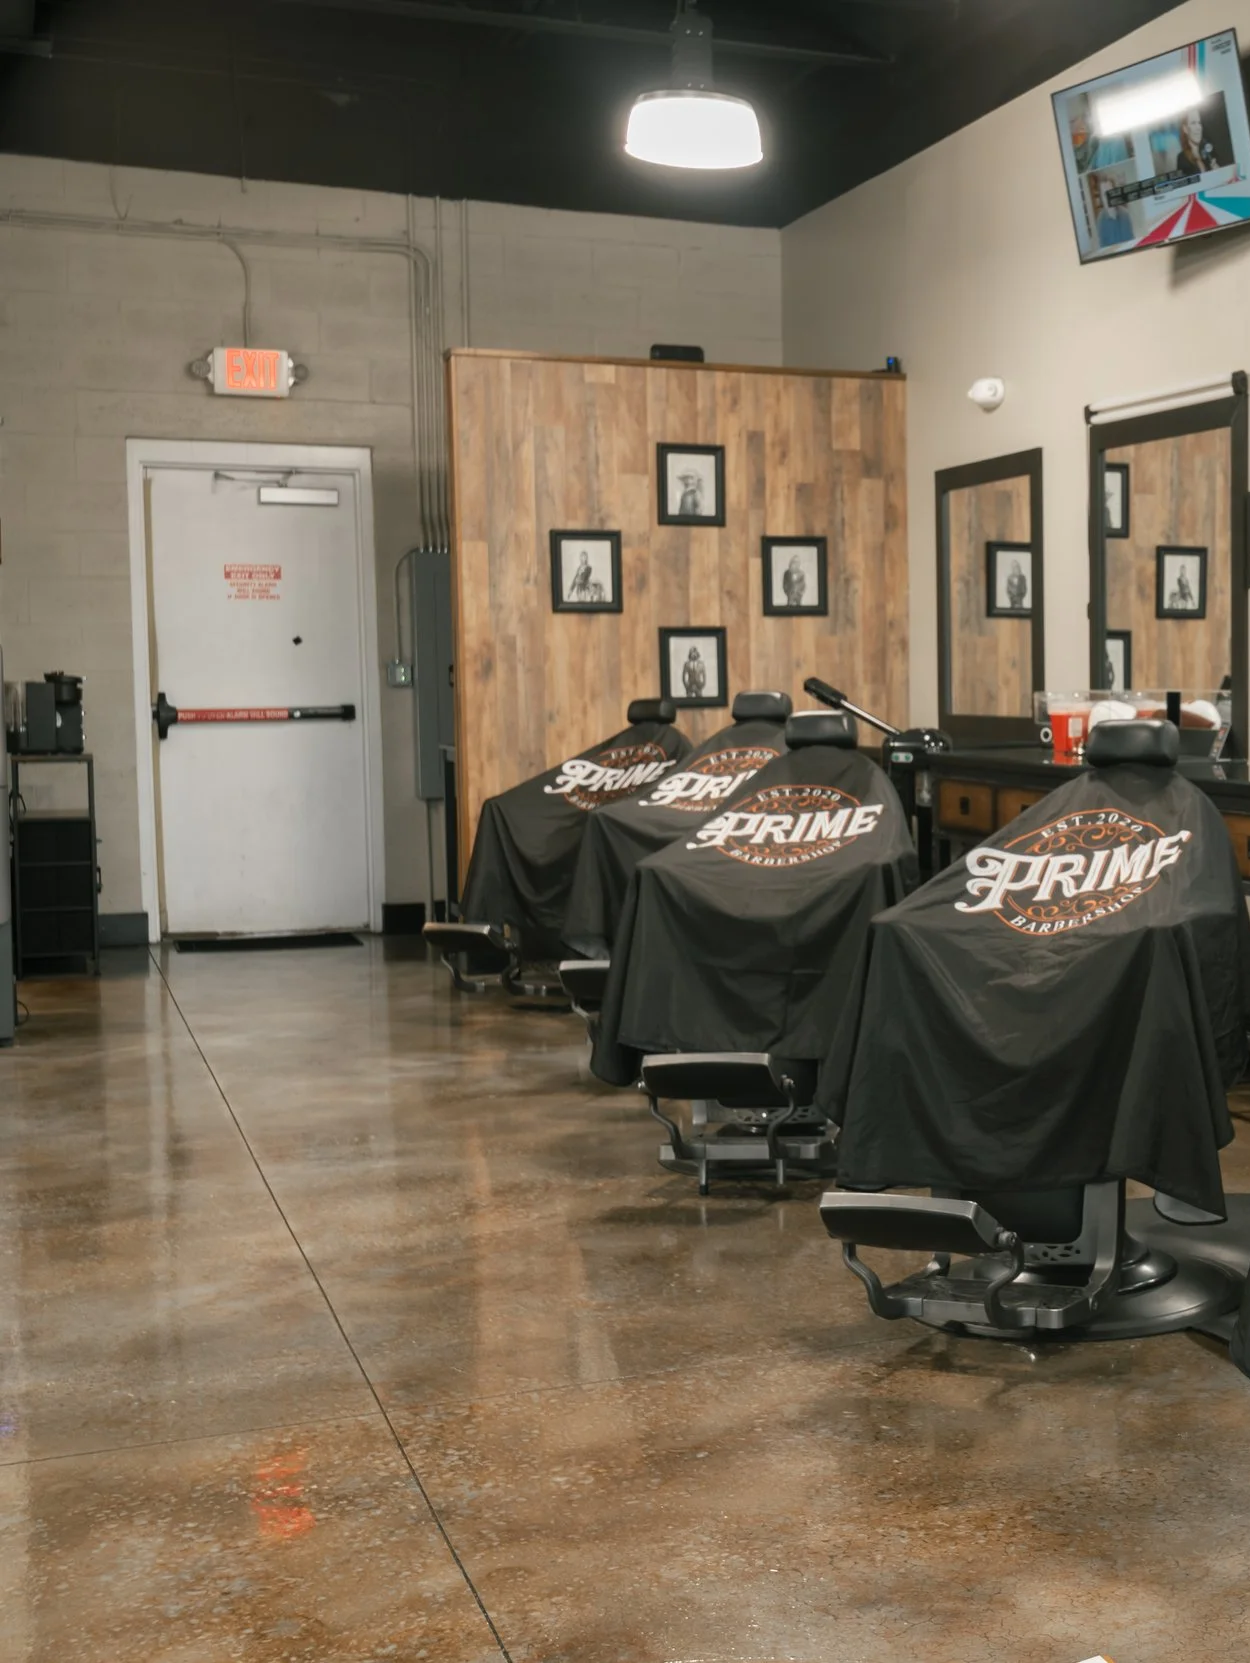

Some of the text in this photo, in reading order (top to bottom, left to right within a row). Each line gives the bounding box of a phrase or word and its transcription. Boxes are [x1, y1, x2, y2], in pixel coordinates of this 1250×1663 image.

[226, 349, 279, 391] EXIT
[231, 571, 275, 579] EXIT ONLY
[544, 759, 677, 795] PRIME
[686, 804, 884, 850] PRIME
[730, 840, 842, 865] BARBERSHOP
[954, 830, 1192, 913] PRIME
[1010, 886, 1144, 933] BARBERSHOP
